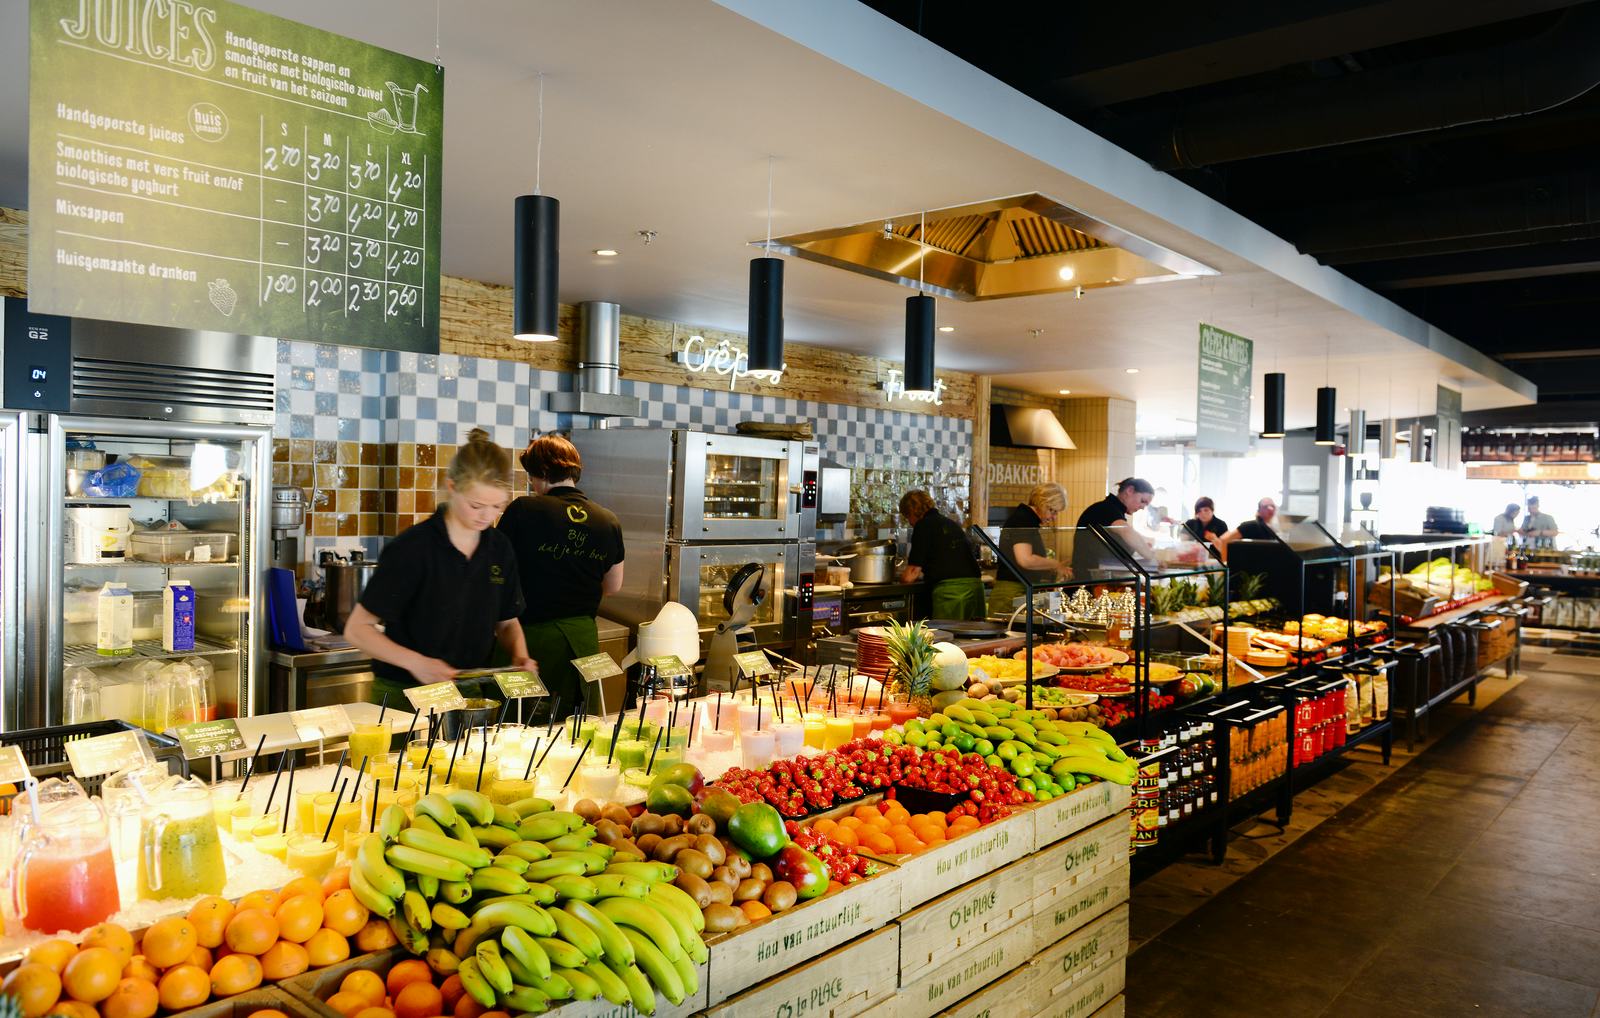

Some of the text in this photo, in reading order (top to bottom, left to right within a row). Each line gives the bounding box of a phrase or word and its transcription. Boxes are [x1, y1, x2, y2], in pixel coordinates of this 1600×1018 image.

[60, 0, 216, 71] JUICES
[225, 31, 350, 78] Handgeperste sappen en
[224, 66, 348, 107] en fruit van het seizoen
[225, 49, 384, 102] smoothies met biologische zuivel
[56, 102, 185, 144] Handgeperste juices
[194, 108, 222, 127] huis
[280, 122, 288, 137] S
[323, 132, 333, 147] M
[367, 143, 373, 157] L
[56, 141, 244, 192] Smoothies met vers fruit en/of
[401, 151, 412, 166] XL
[56, 161, 180, 197] biologische yoghurt
[56, 199, 125, 225] Mixsappen
[56, 249, 198, 283] Huisgemaakte dranken
[28, 331, 48, 341] G2
[32, 369, 46, 380] 04
[936, 858, 952, 876] Hou
[955, 848, 968, 867] van
[973, 890, 996, 918] PLACE
[757, 901, 861, 963] Hou van natuurlijk
[810, 977, 842, 1010] PLACE
[928, 982, 944, 1002] Hou
[947, 972, 961, 990] van
